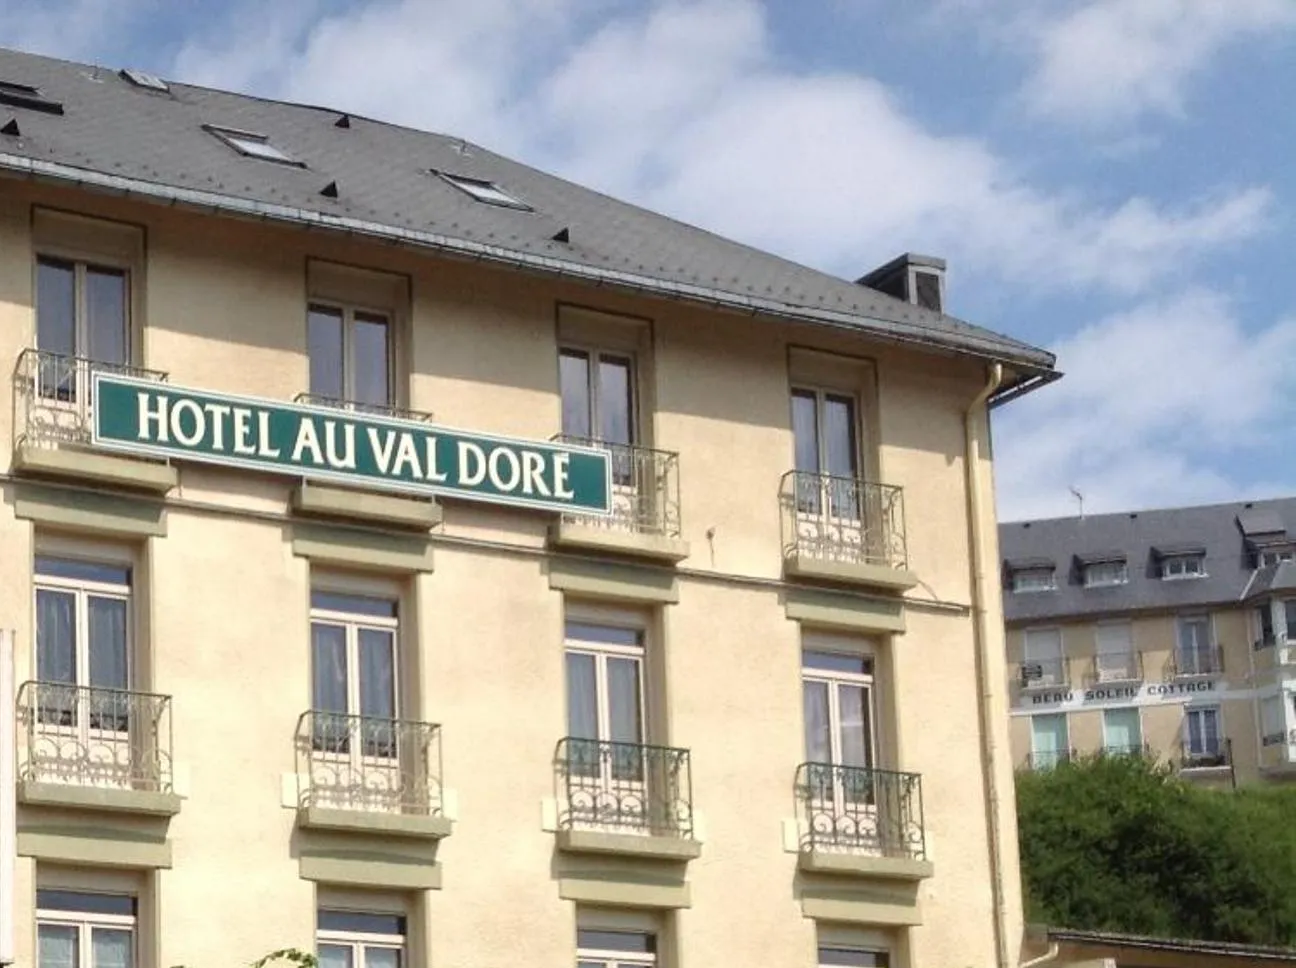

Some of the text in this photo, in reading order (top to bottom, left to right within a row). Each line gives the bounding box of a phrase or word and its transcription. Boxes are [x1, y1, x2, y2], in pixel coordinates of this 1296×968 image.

[137, 393, 576, 500] HOTEL AU VAL DORÉ
[1085, 687, 1137, 701] SOLEIL
[1147, 681, 1217, 696] COTTAGE
